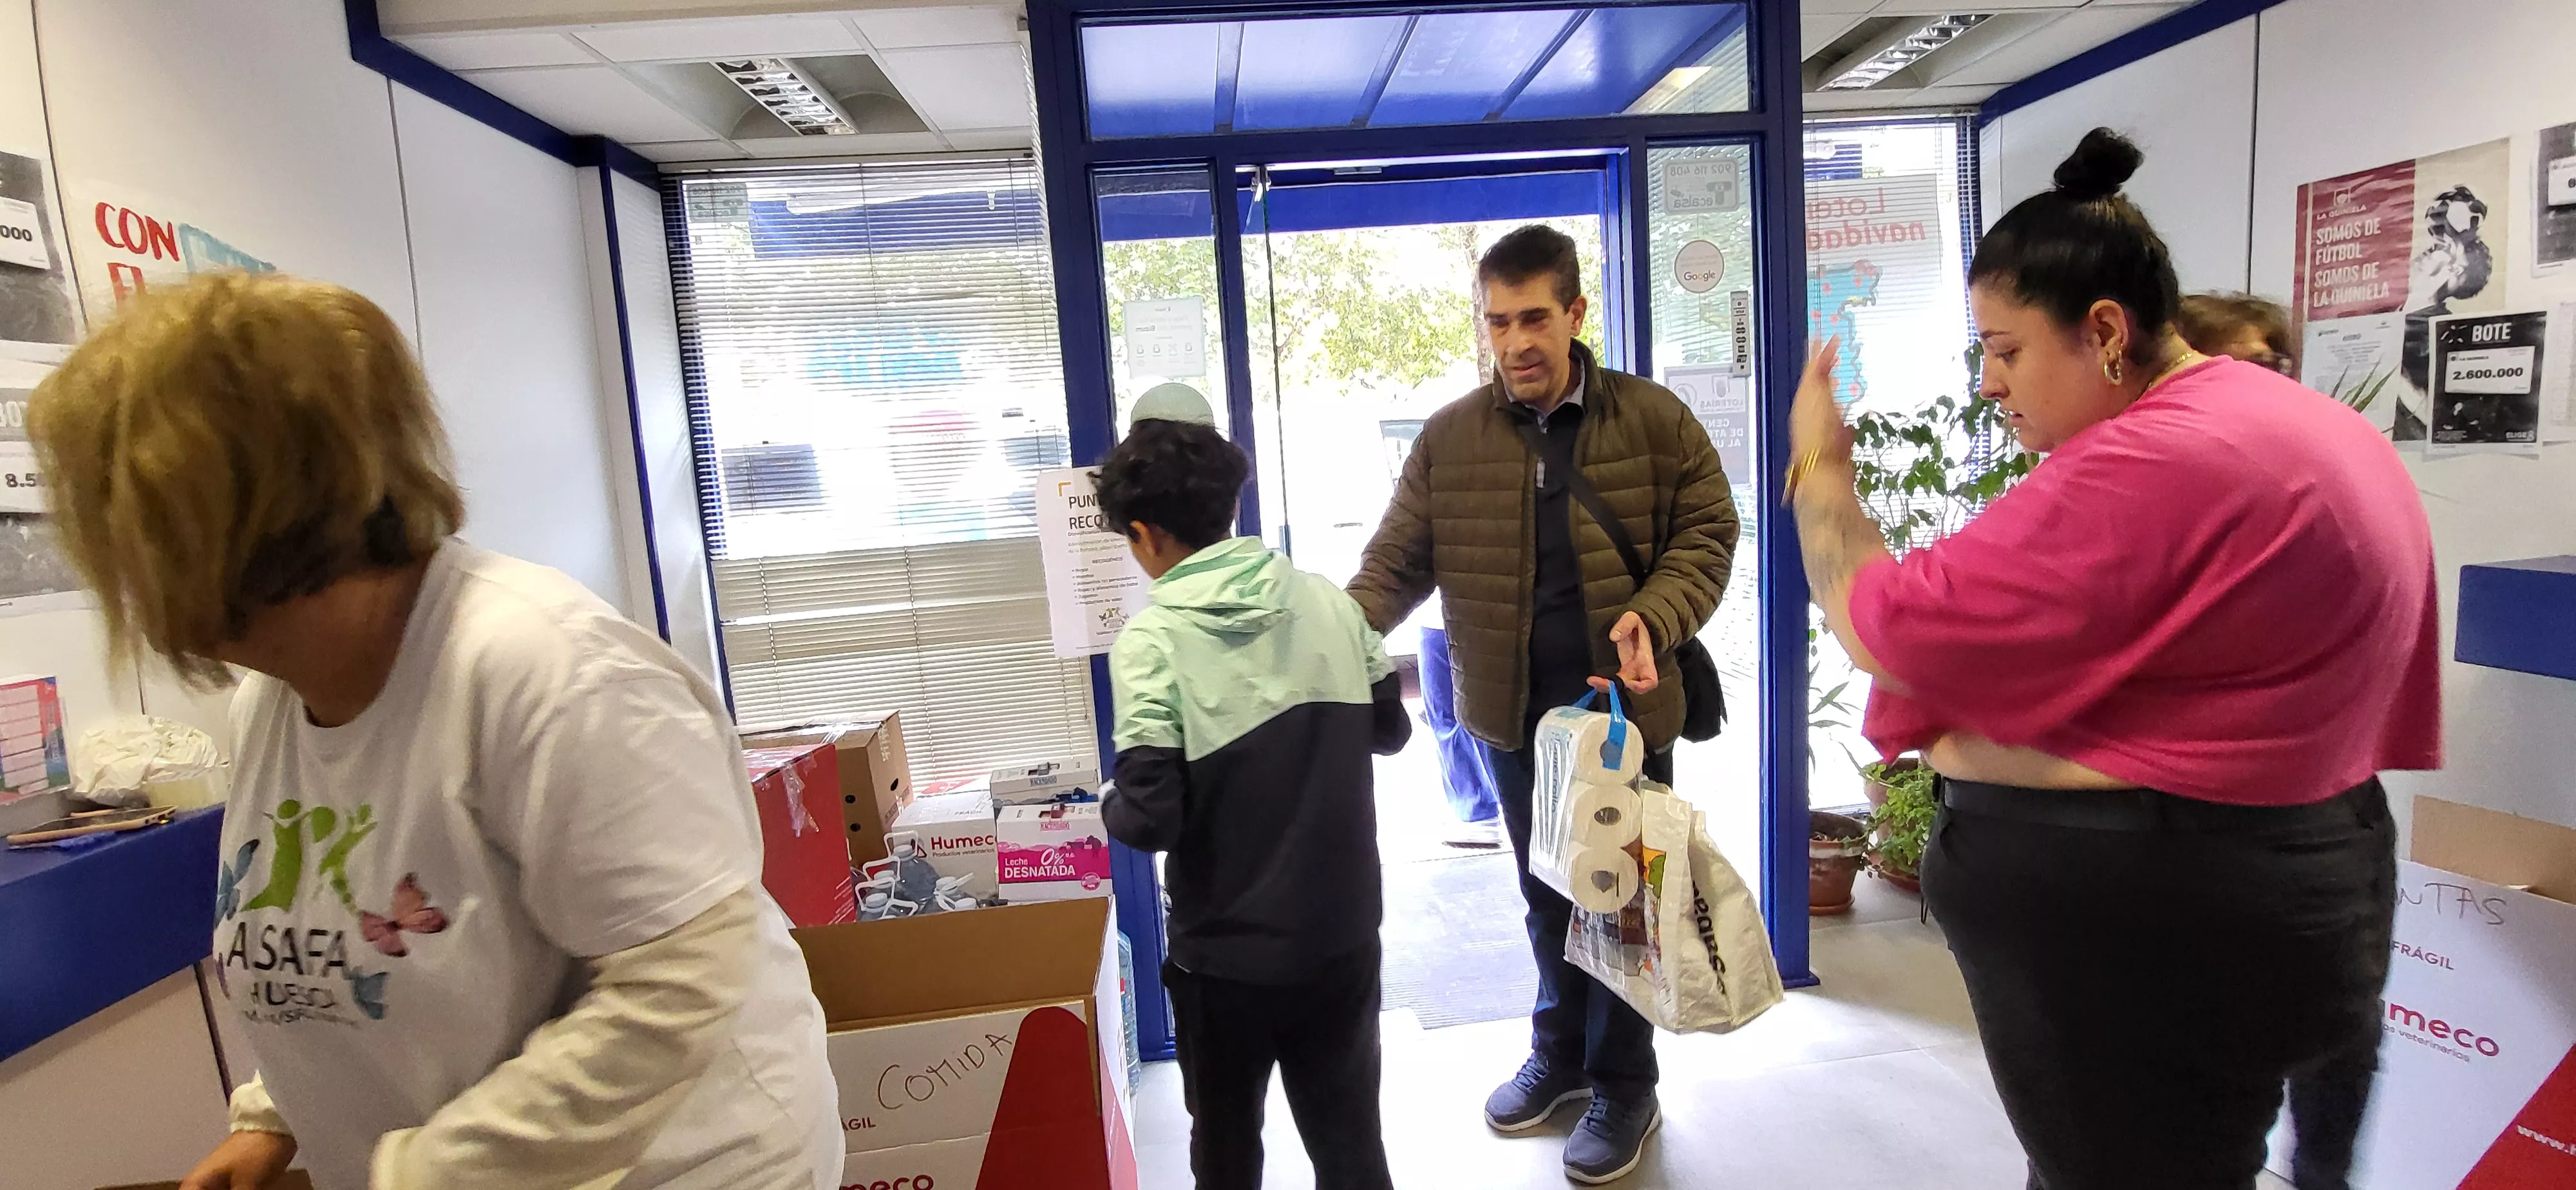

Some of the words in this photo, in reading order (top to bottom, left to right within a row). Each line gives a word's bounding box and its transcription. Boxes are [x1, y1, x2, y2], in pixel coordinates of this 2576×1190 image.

[95, 202, 180, 261] CON
[2316, 222, 2362, 245] SOMOS
[2364, 217, 2382, 236] DE
[2315, 242, 2362, 265] FÚTBOL
[1683, 270, 1716, 281] Google
[2314, 265, 2360, 288] SOMOS
[2362, 261, 2379, 280] DE
[2313, 291, 2329, 307] LA
[2331, 281, 2389, 305] QUINIELA
[2471, 322, 2512, 342] BOTE
[2452, 367, 2524, 380] 2.600.000
[1005, 858, 1028, 866] Leche
[1041, 848, 1065, 865] 0%
[1005, 865, 1075, 878] DESNATADA
[227, 921, 352, 980] ASAFA
[2385, 1002, 2499, 1057] meco
[2399, 1030, 2470, 1062] veterinarios
[877, 1034, 1012, 1110] COMIDA
